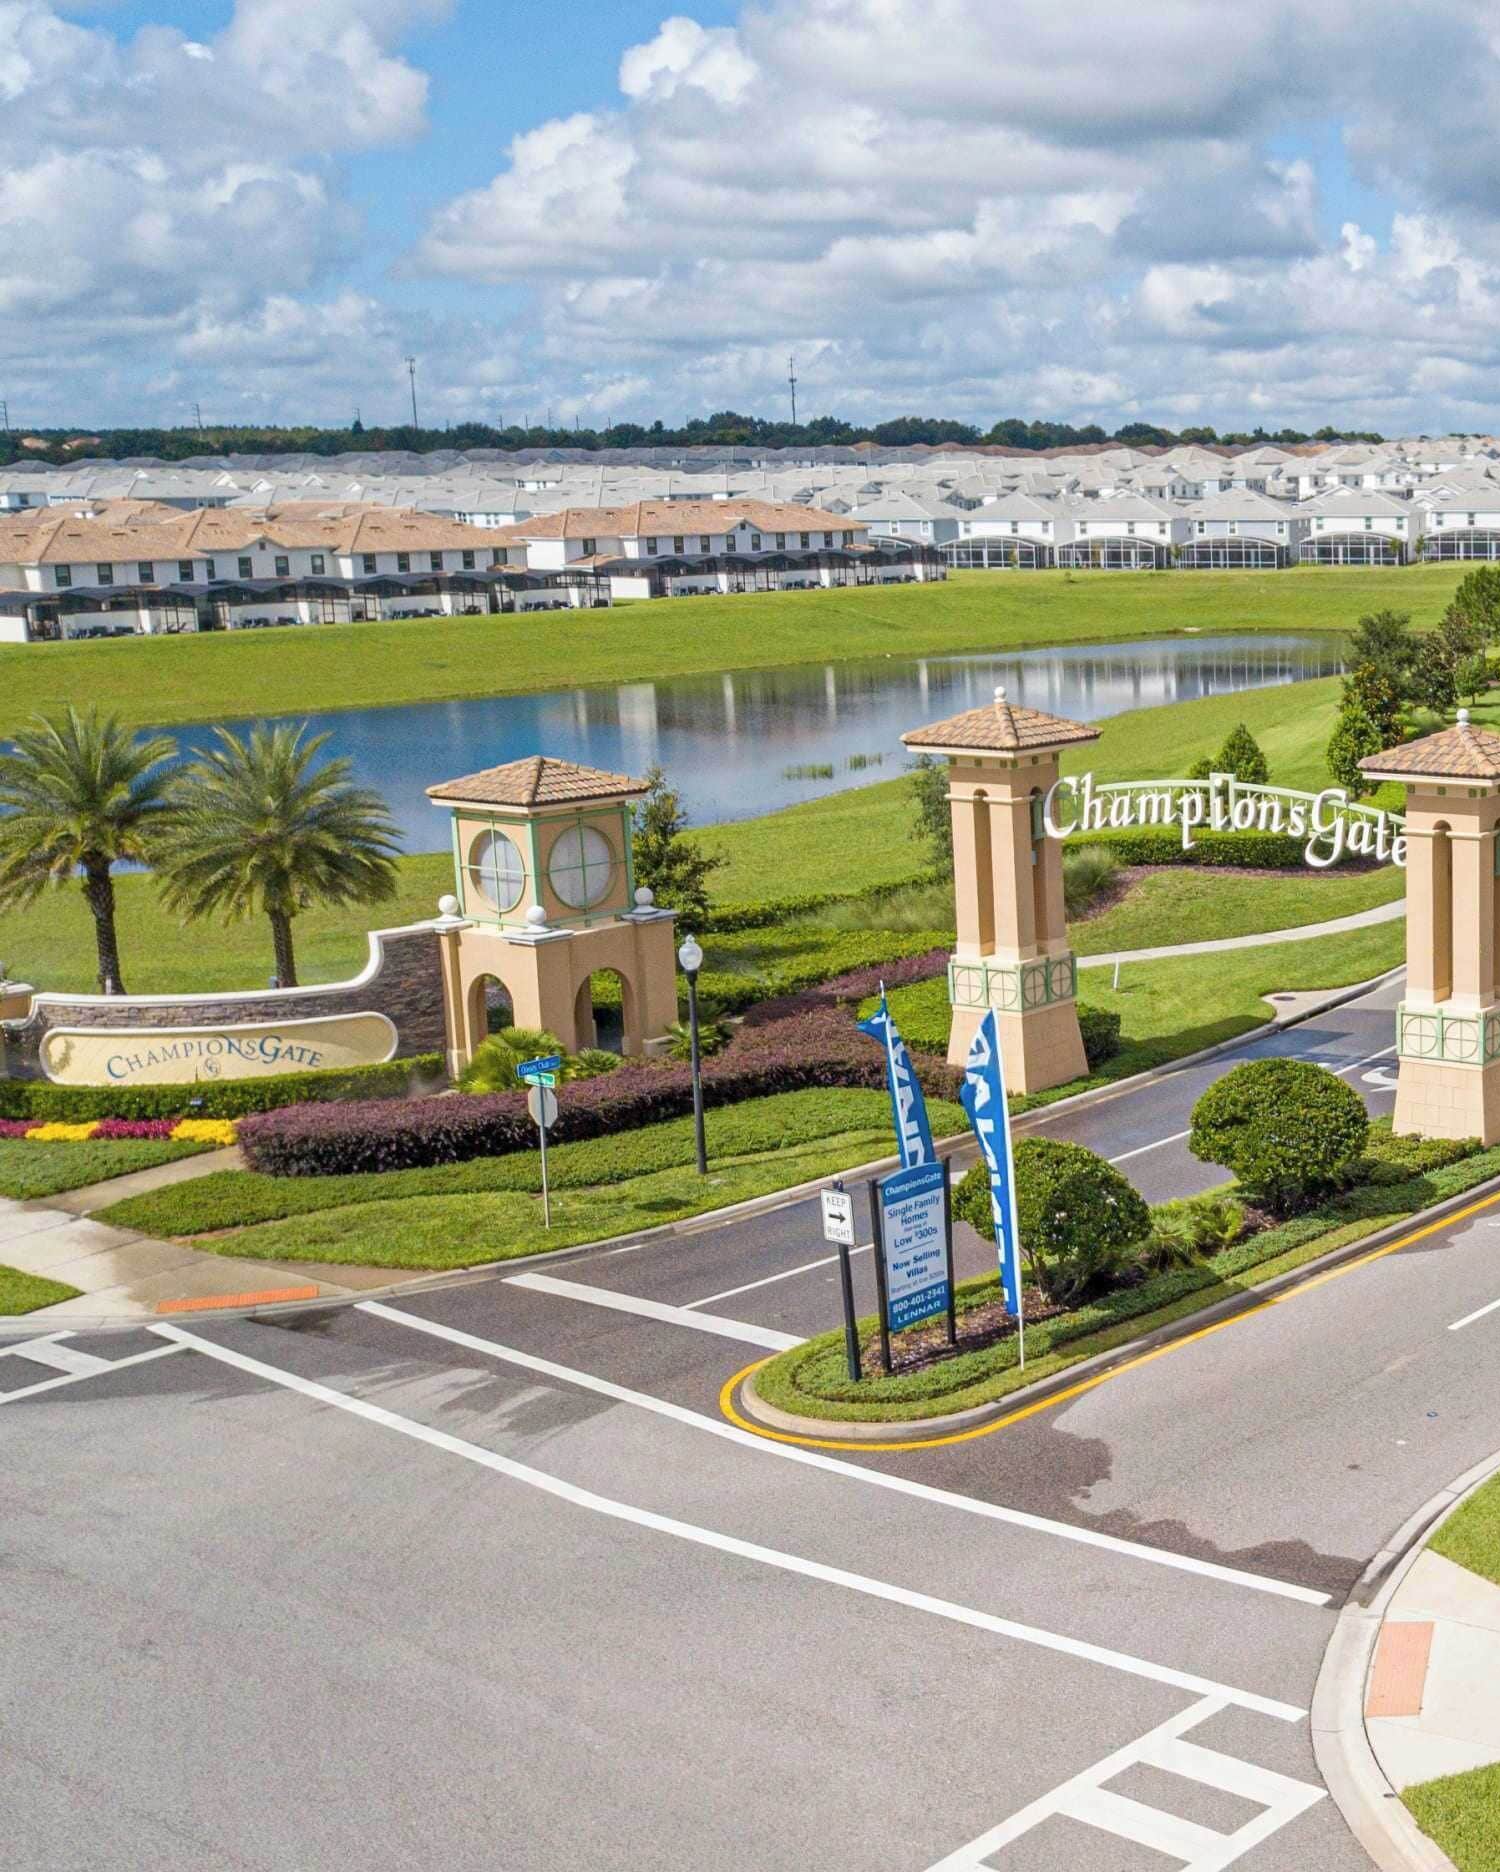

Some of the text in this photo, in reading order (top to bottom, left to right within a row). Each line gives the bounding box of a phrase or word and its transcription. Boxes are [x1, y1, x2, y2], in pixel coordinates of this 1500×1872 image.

[1043, 771, 1407, 867] ChampionsGate
[885, 1172, 942, 1197] ChampionsGate
[825, 1196, 847, 1208] KEEP
[887, 1194, 941, 1219] Single Family
[900, 1210, 929, 1226] Homes
[826, 1225, 852, 1239] RIGHT
[894, 1236, 913, 1248] Low
[892, 1248, 941, 1272] Now Selling
[906, 1264, 928, 1279] Villas
[897, 1300, 942, 1323] LENNAR
